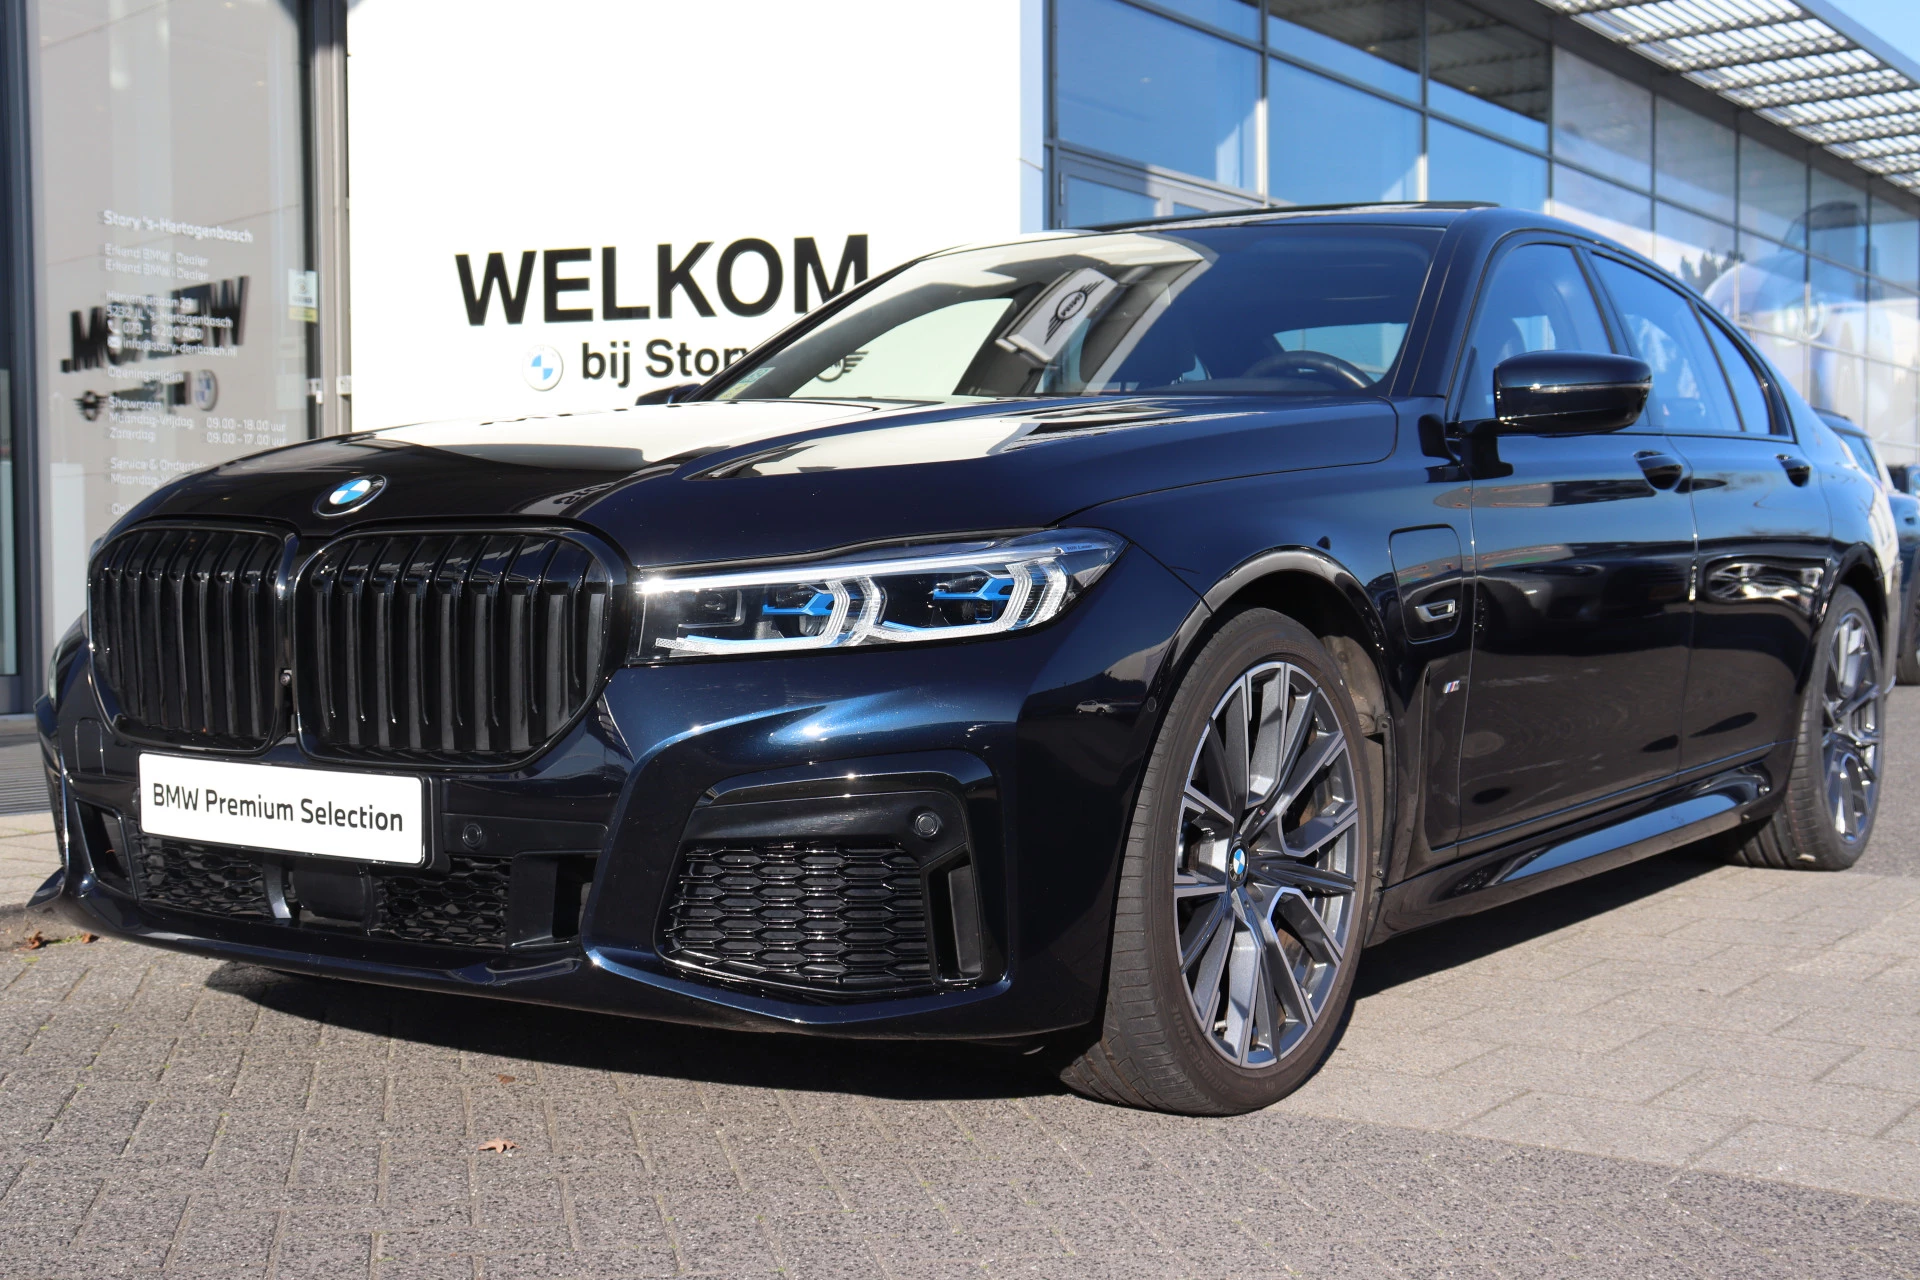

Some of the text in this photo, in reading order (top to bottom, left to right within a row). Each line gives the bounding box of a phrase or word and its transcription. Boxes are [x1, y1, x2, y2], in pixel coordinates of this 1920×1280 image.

[104, 210, 140, 231] Story
[455, 234, 868, 326] WELKOM
[107, 305, 132, 318] 5232
[582, 339, 748, 387] bij Stor
[109, 397, 162, 412] Showroom
[206, 417, 235, 430] 09.00
[153, 783, 403, 832] BMW Premium Selection
